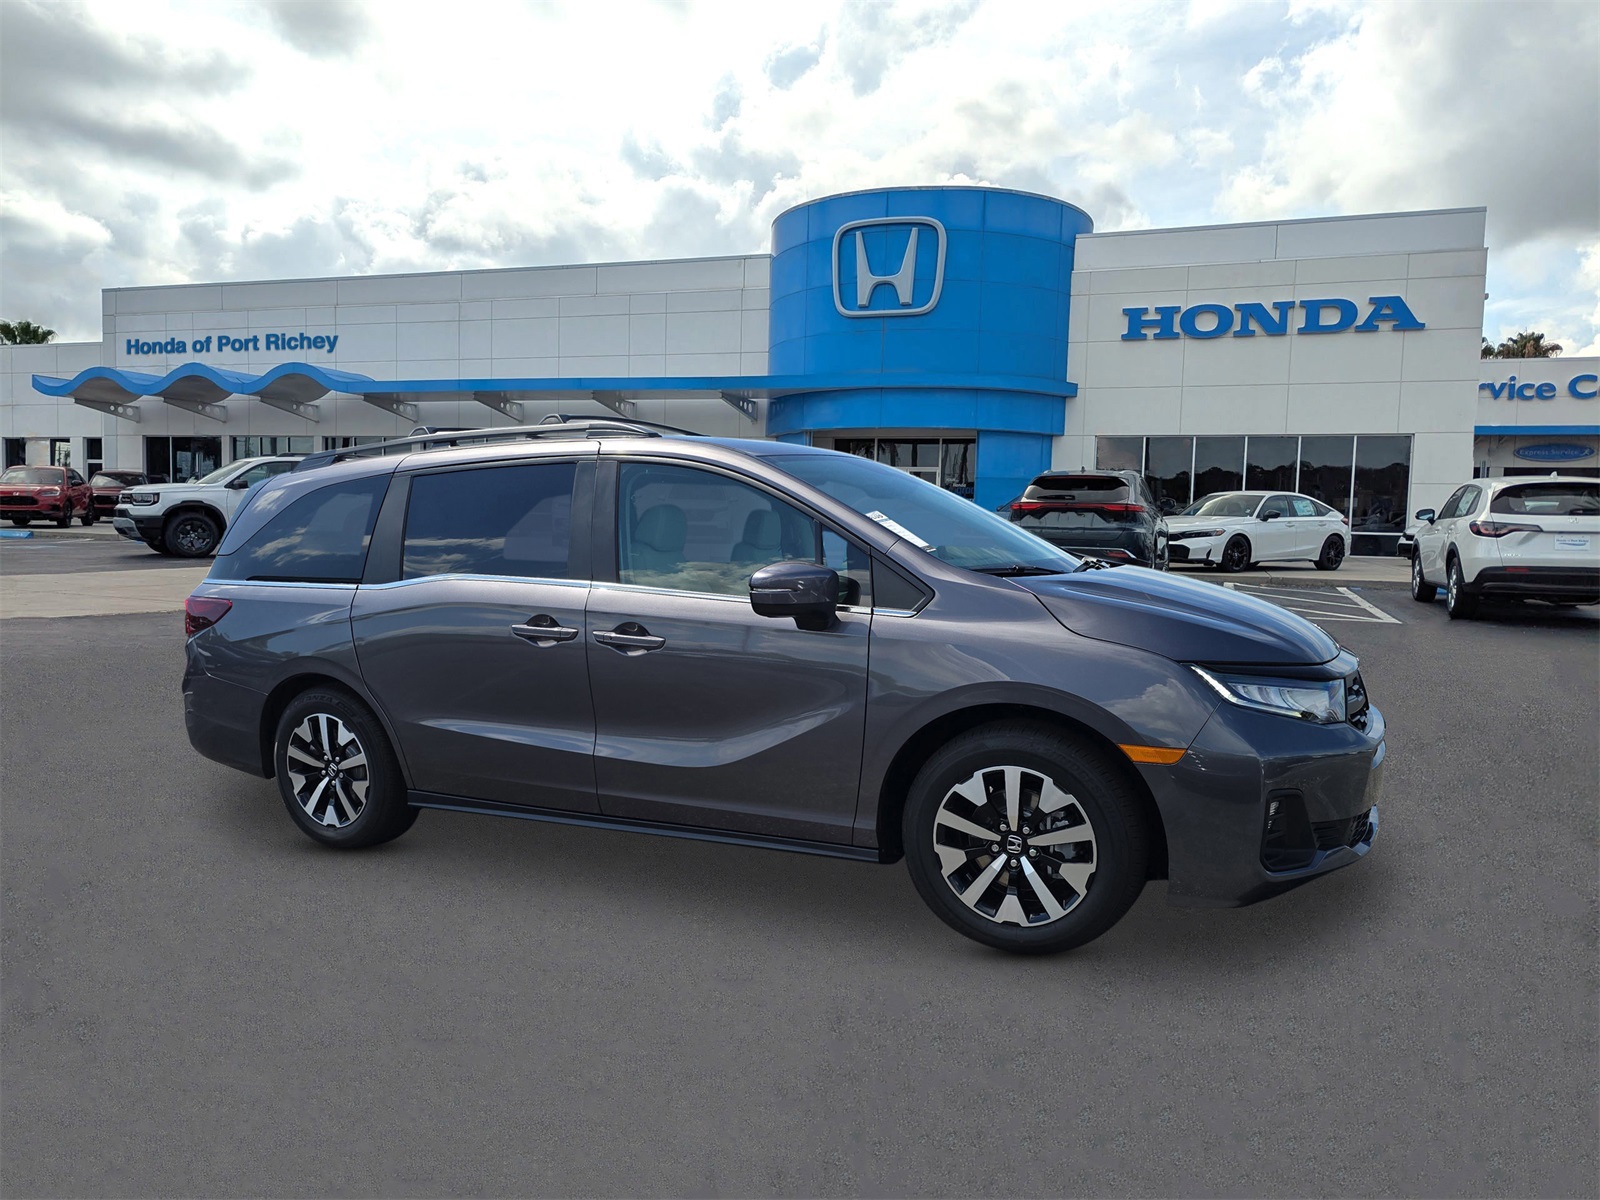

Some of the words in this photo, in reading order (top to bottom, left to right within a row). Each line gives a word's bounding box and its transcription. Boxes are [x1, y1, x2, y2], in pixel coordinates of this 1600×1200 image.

[1121, 296, 1426, 340] HONDA
[126, 338, 187, 355] Honda
[192, 336, 212, 353] of
[217, 334, 259, 352] Port
[265, 332, 339, 353] Richey
[1519, 448, 1549, 456] Express
